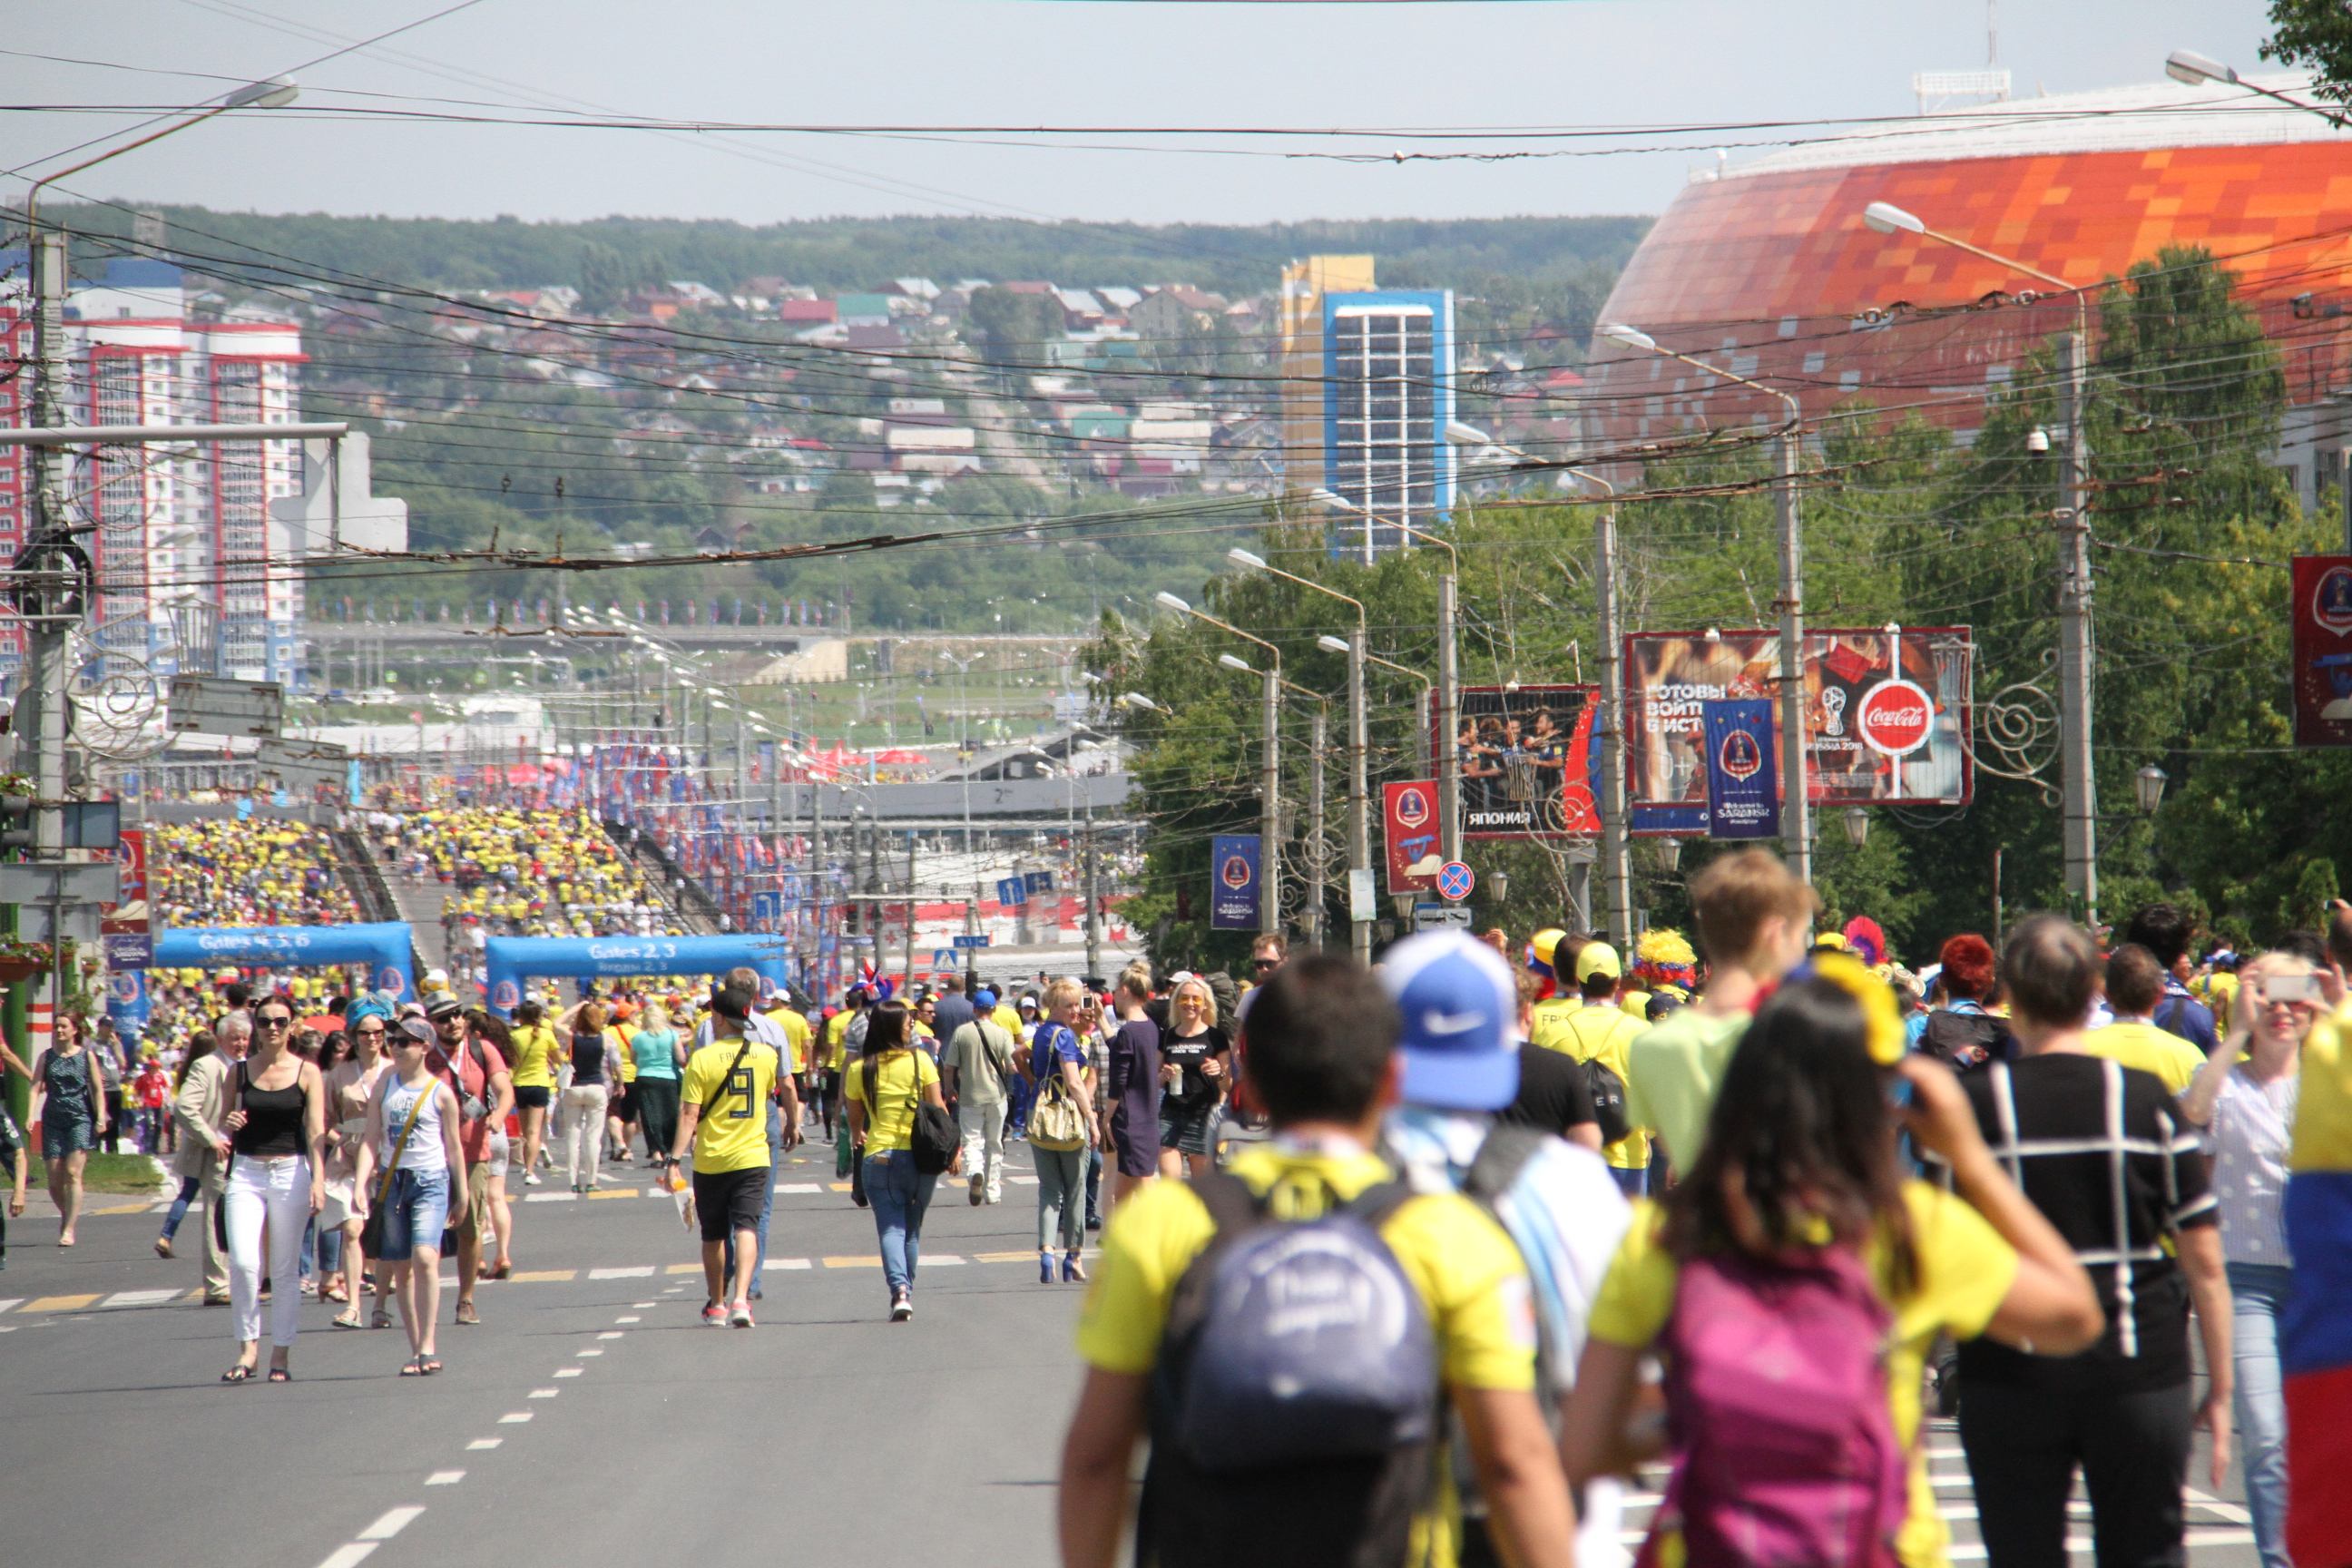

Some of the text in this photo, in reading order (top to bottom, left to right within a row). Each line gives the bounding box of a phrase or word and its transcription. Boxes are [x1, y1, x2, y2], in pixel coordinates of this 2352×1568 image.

[1646, 684, 1726, 700] ГОТОВЫ
[1646, 718, 1660, 732] В
[1867, 707, 1926, 727] Coca-Cola
[1469, 811, 1531, 825] ЯПОНИЯ
[199, 934, 252, 950] Gates
[588, 943, 641, 959] Gates
[719, 1050, 758, 1063] FALAO
[727, 1066, 754, 1119] 9
